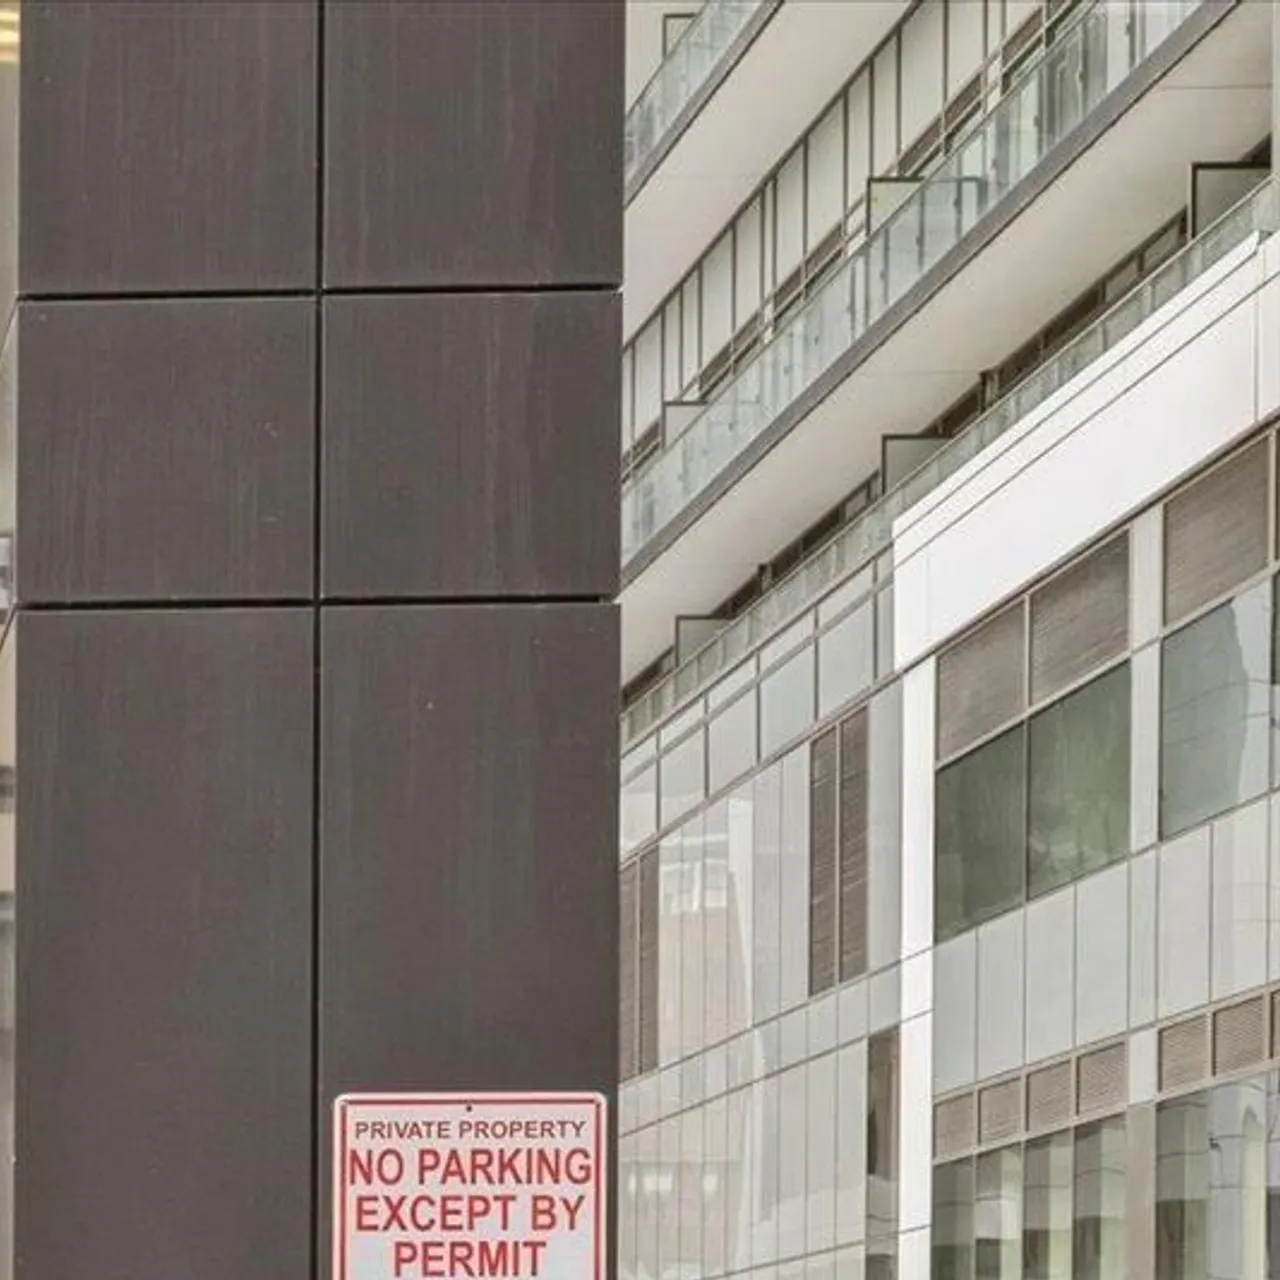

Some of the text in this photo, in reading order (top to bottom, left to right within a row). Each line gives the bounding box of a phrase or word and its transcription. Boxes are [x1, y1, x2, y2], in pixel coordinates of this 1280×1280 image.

[354, 1120, 587, 1140] PRIVATE PROPERTY
[349, 1147, 592, 1185] NO PARKING
[355, 1195, 586, 1232] EXCEPT BY
[393, 1241, 547, 1277] PERMIT
